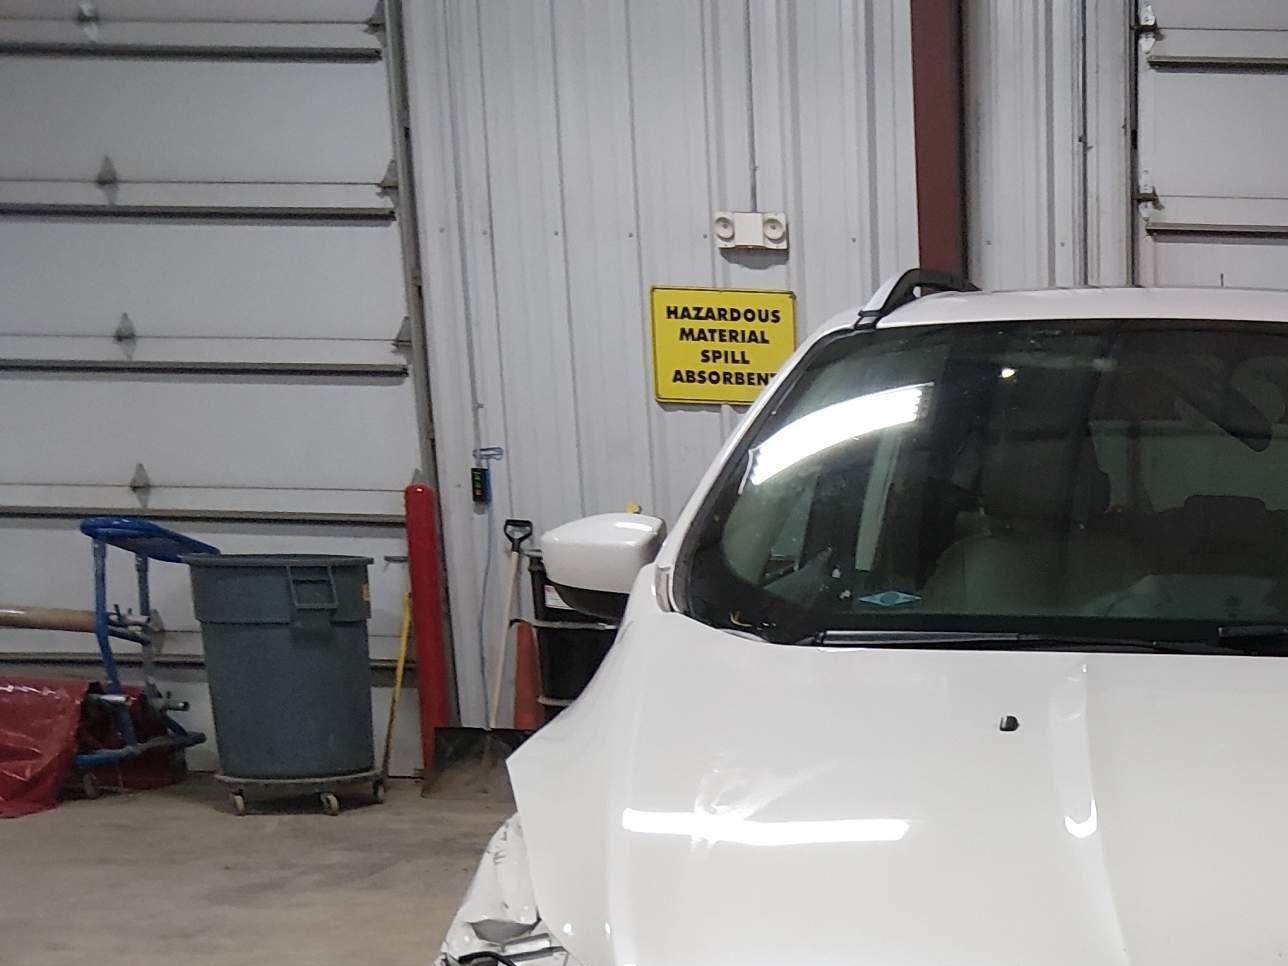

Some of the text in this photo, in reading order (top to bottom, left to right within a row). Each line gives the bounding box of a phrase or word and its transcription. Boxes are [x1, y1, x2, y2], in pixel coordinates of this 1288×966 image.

[666, 305, 781, 323] HAZARDOUS
[679, 327, 769, 344] MATERIAL
[700, 349, 750, 364] SPILL
